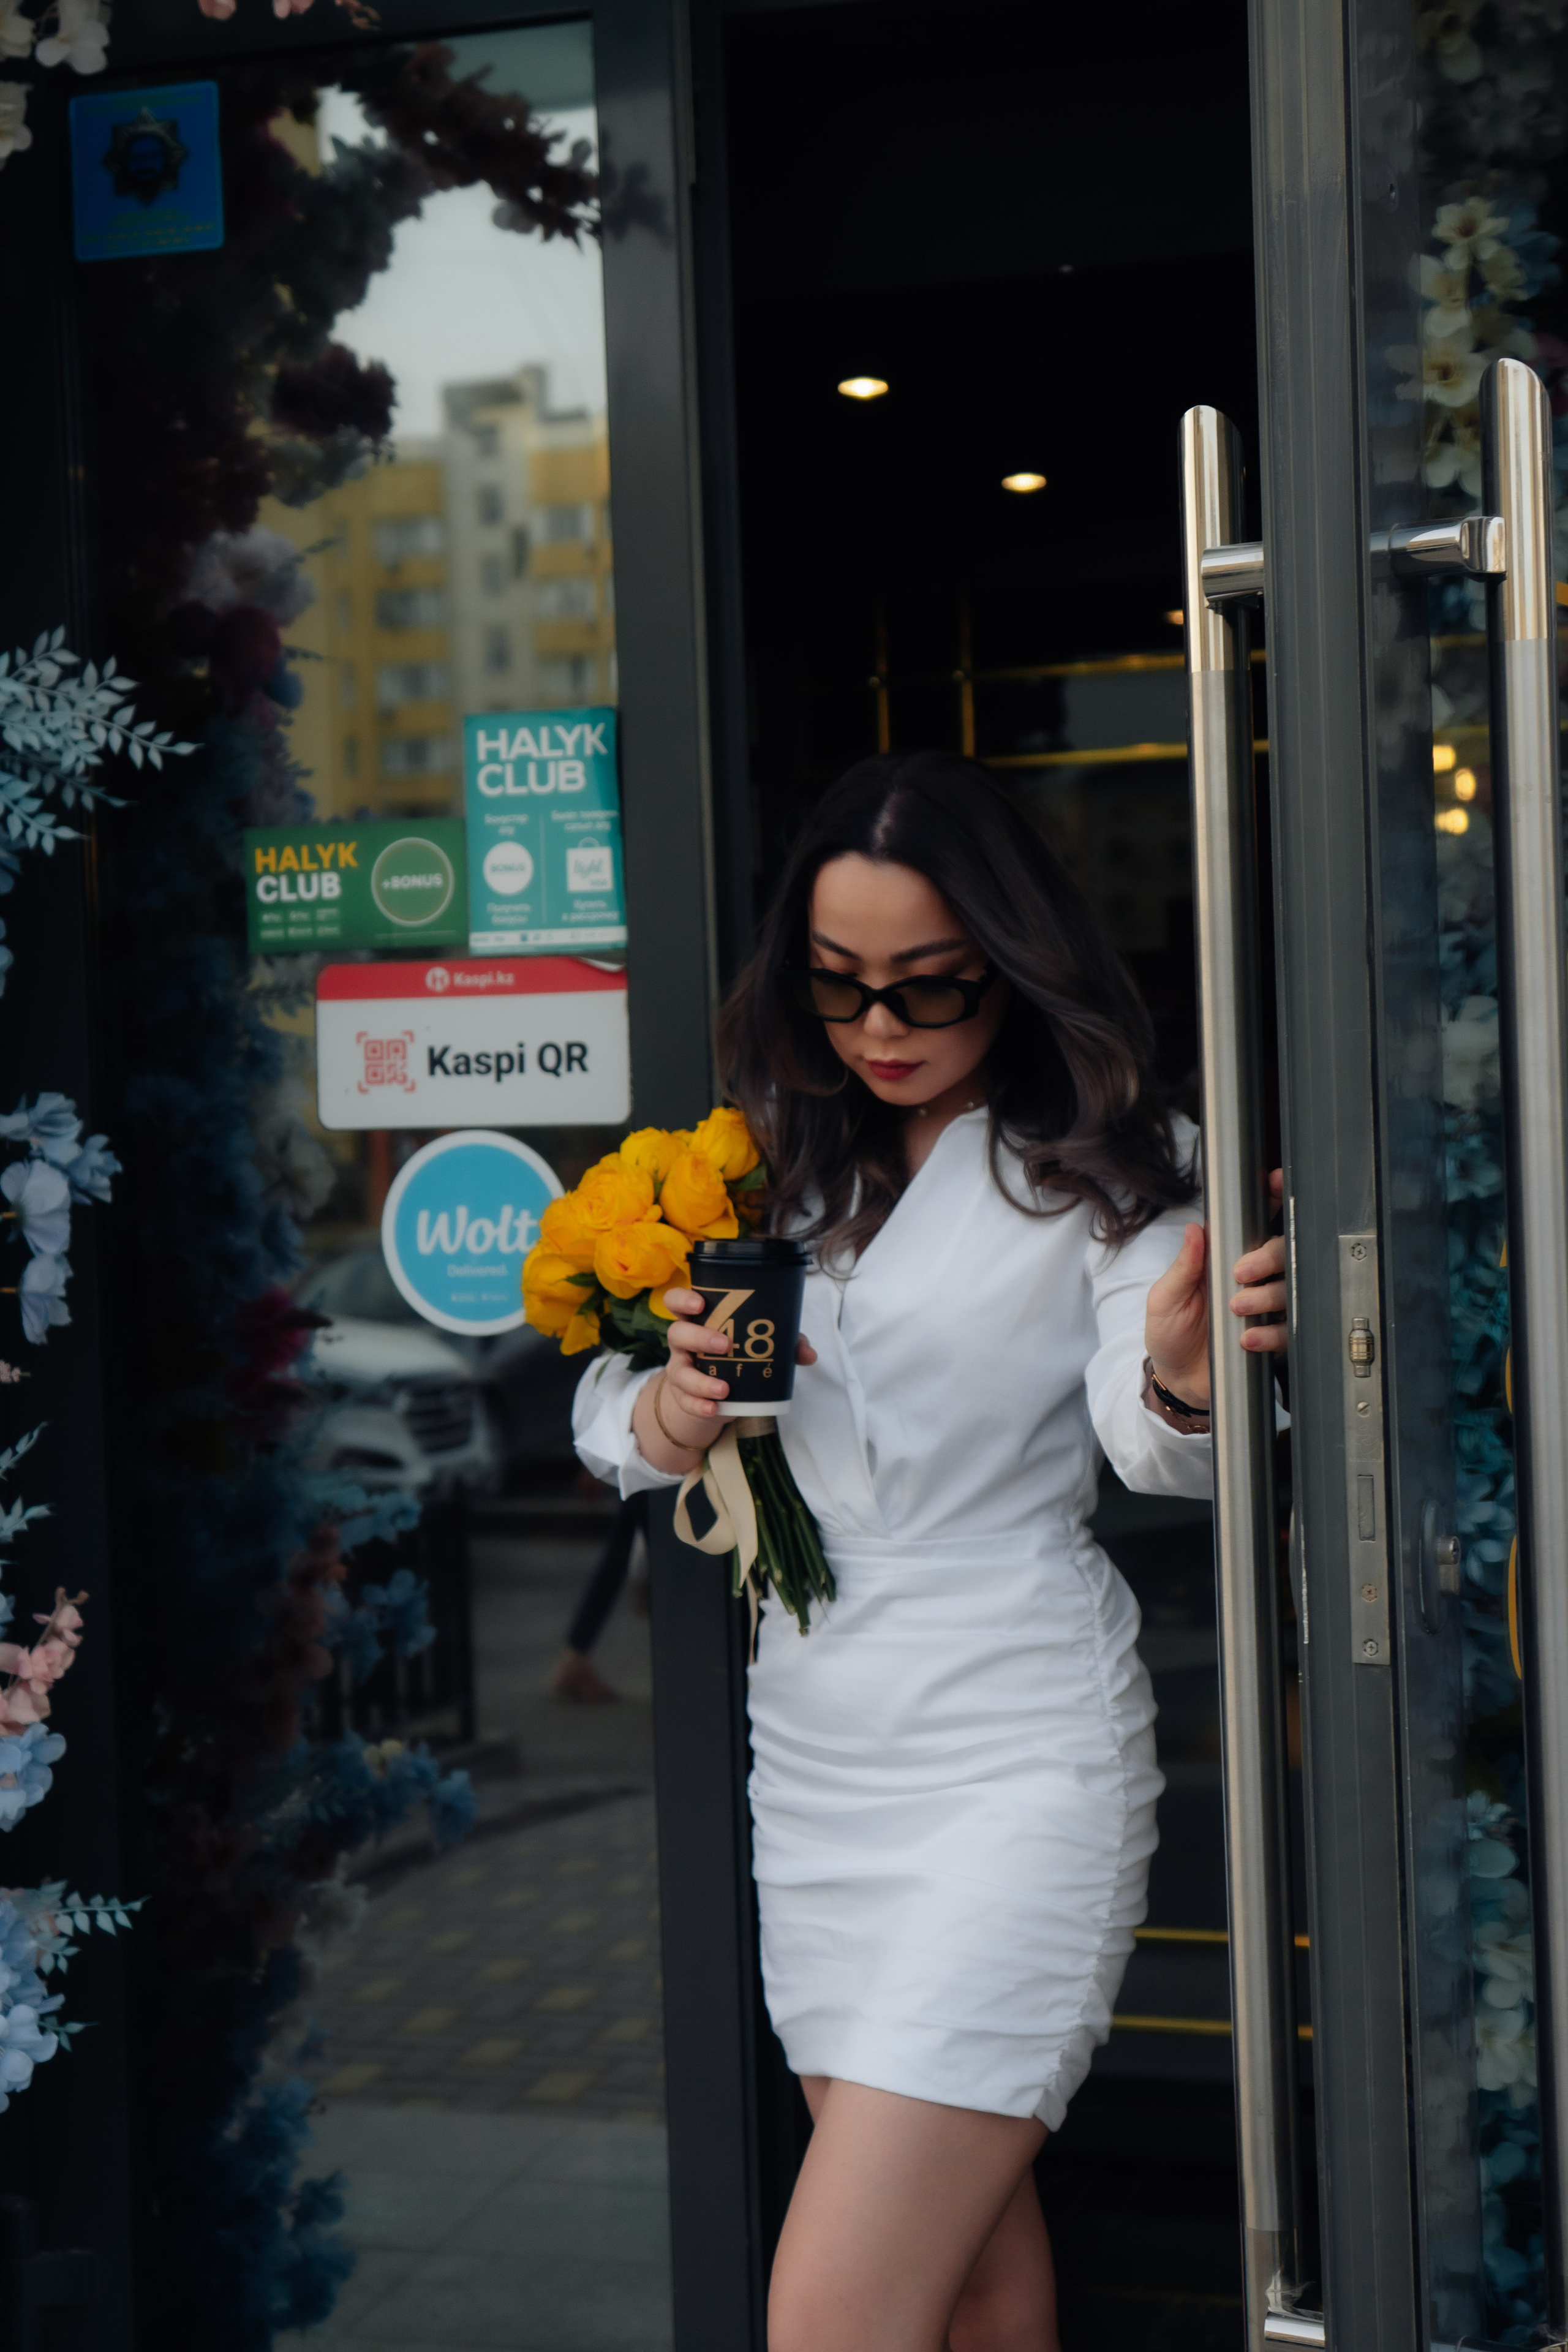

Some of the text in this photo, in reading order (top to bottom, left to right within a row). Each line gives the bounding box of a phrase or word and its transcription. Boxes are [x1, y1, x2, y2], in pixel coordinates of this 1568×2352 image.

[477, 723, 608, 761] HALYK
[477, 760, 586, 796] CLUB
[255, 842, 358, 873] HALYK
[257, 872, 341, 903] CLUB
[428, 1042, 589, 1084] Kaspi QR
[417, 1204, 539, 1254] Wolt
